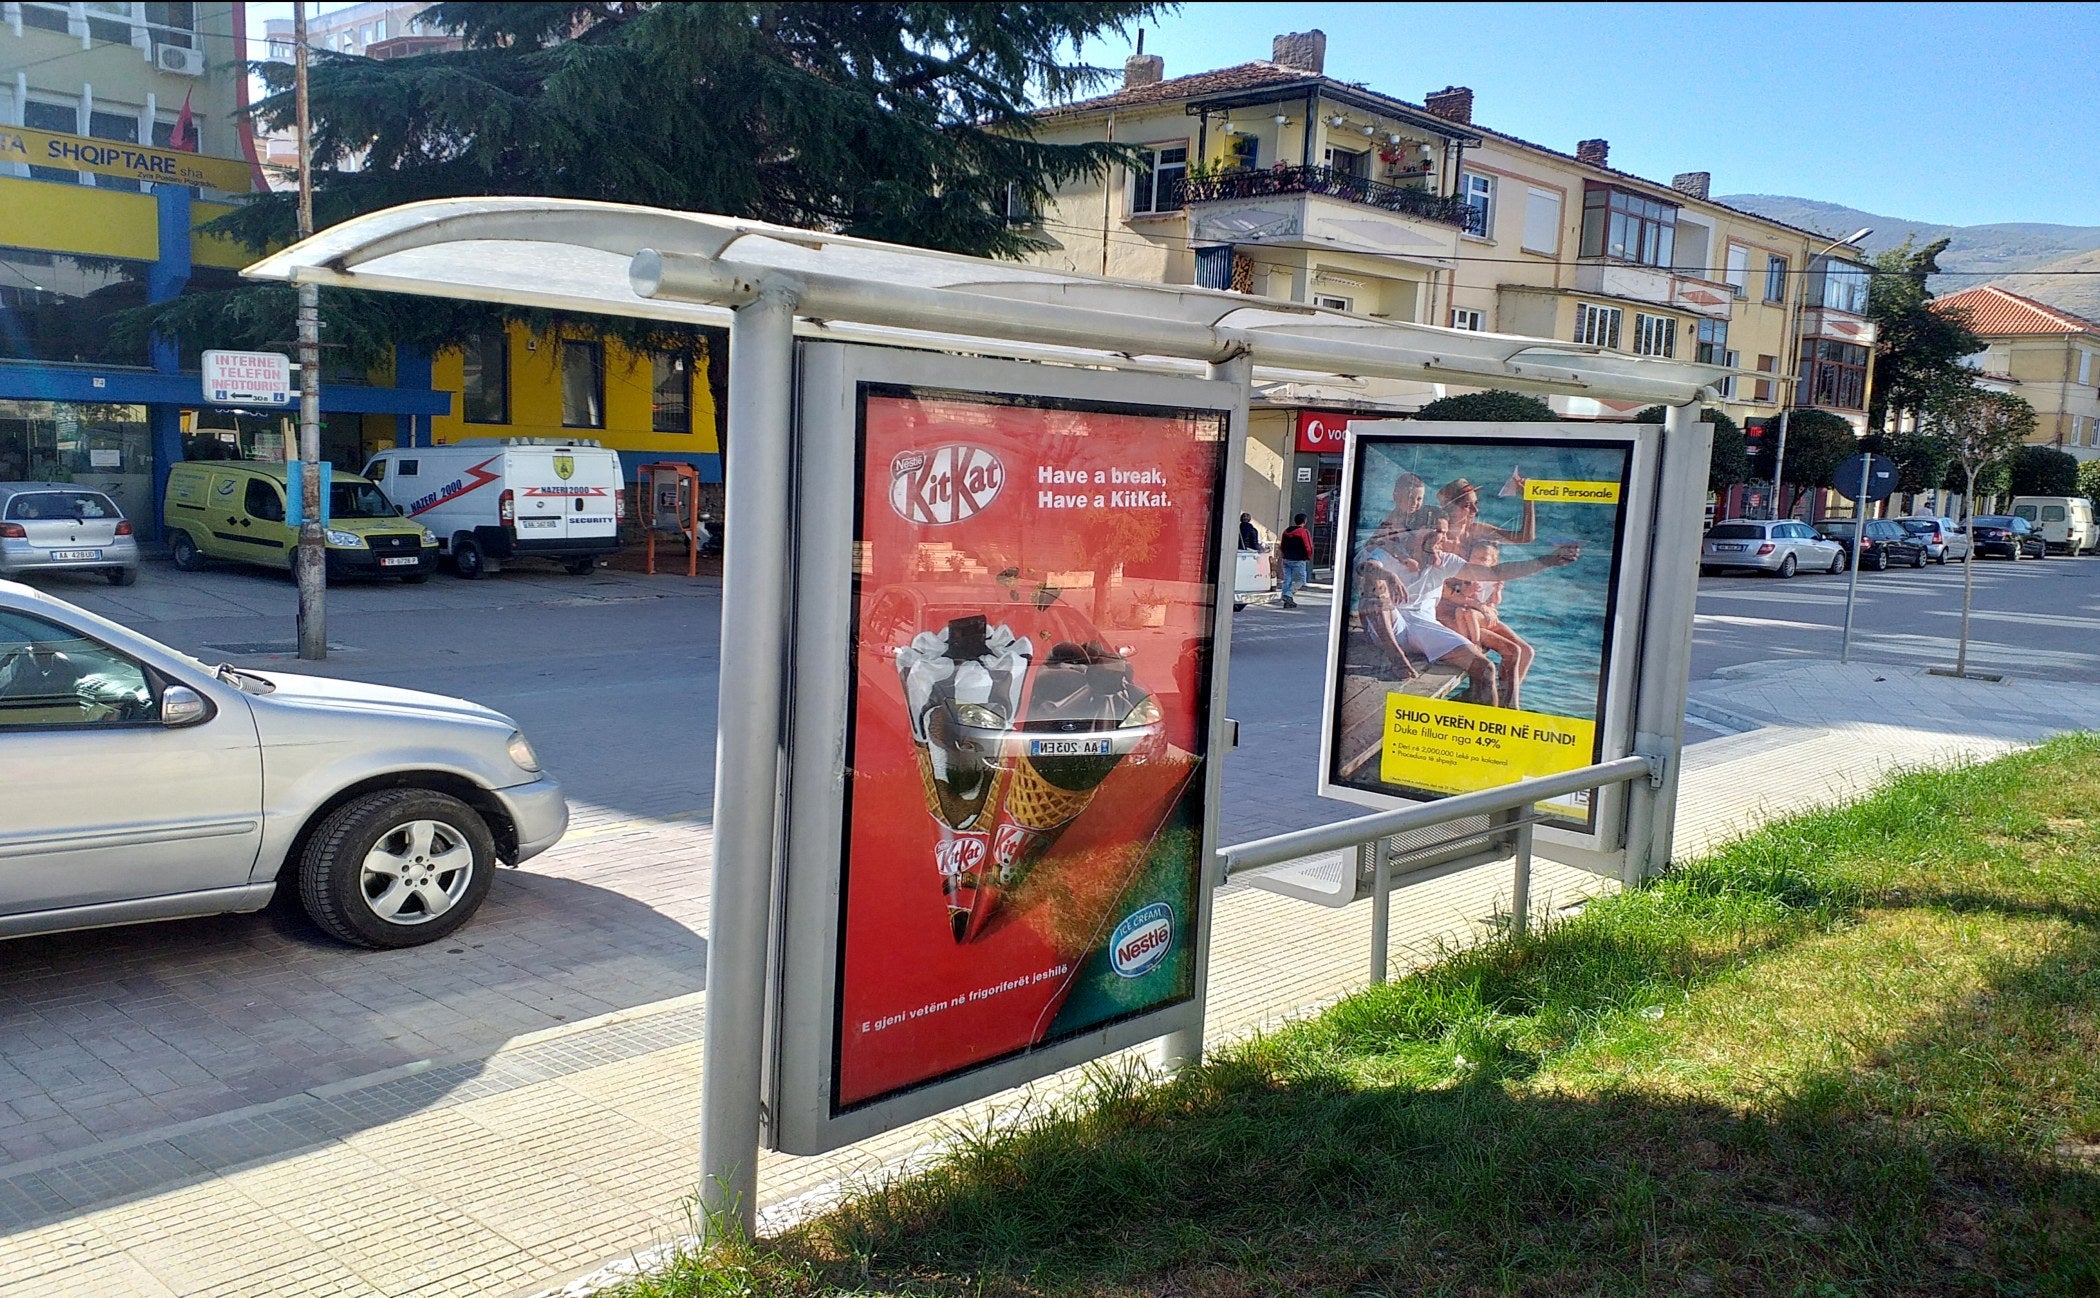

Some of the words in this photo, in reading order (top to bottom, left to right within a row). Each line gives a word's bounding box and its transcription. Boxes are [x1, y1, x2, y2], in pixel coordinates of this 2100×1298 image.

[48, 140, 176, 175] SHQIPTARE
[180, 167, 203, 179] sha
[215, 355, 283, 368] INTERNET
[219, 367, 281, 380] TELEFON
[211, 379, 288, 391] INFOTOURIST
[905, 446, 998, 523] KitKat
[1038, 466, 1088, 484] Have
[1094, 470, 1105, 484] a
[1111, 467, 1167, 487] break,
[411, 492, 437, 513] NAZERI
[441, 479, 462, 498] 2000
[541, 486, 568, 494] NAZERI
[569, 486, 589, 494] 2000
[1038, 491, 1088, 508] Have
[1093, 494, 1105, 508] a
[1111, 490, 1171, 508] KitKat.
[1532, 486, 1559, 496] Kredi
[1562, 487, 1612, 498] Personale
[569, 517, 614, 525] SECURITY
[1394, 723, 1418, 736] Duke
[1421, 726, 1448, 742] filluar
[1452, 734, 1472, 746] nga
[1475, 737, 1501, 749] 4.9%
[1395, 709, 1430, 724] SHIJO
[1434, 715, 1475, 731] VERËN
[1479, 721, 1506, 735] DERI
[1510, 724, 1529, 739] NË
[1533, 729, 1576, 746] FUND!
[1397, 750, 1427, 761] Procedura
[1421, 745, 1454, 757] 2,000,000
[940, 840, 980, 873] KitKat
[1120, 920, 1132, 936] ICE
[1133, 908, 1162, 927] CREAM
[862, 1021, 871, 1033] E
[874, 1011, 906, 1031] gjeni
[909, 1001, 948, 1019] vetëm
[951, 993, 966, 1007] në
[968, 975, 1030, 1002] frigoriferët
[1032, 963, 1068, 984] jeshilë
